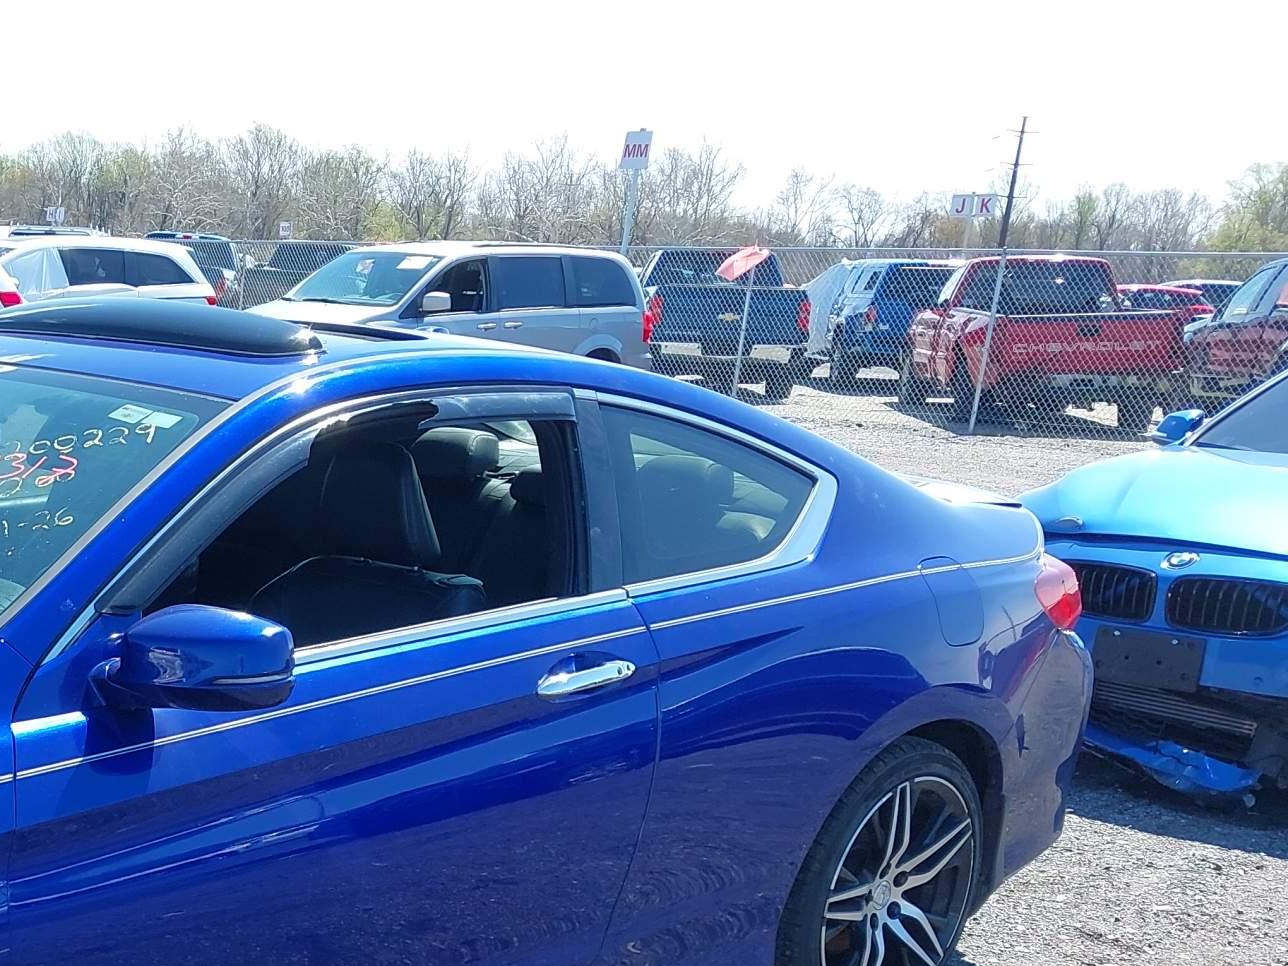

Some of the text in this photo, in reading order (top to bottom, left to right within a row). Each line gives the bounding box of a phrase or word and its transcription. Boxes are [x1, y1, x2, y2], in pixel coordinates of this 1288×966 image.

[623, 143, 649, 158] MM
[955, 198, 966, 213] J
[980, 198, 992, 213] K
